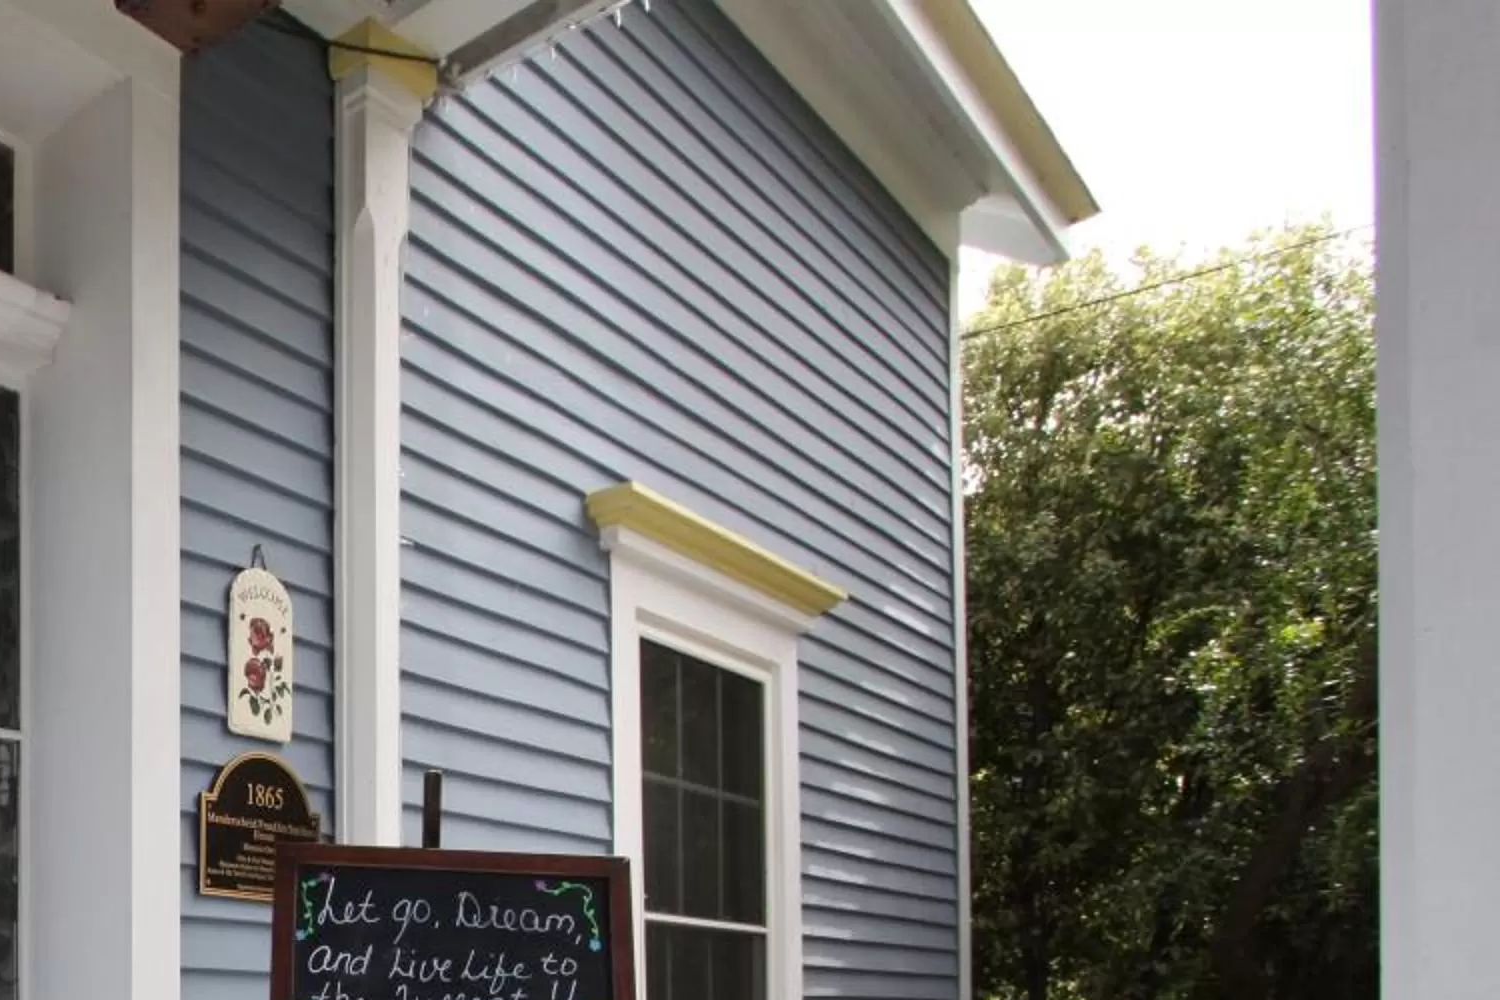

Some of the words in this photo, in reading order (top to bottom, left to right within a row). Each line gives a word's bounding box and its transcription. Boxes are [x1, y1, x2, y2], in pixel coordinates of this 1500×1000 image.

[247, 783, 284, 809] 1865
[318, 877, 380, 926] Let
[455, 891, 582, 945] Dream,
[389, 947, 452, 983] Live
[461, 949, 532, 993] Life
[541, 954, 578, 974] to
